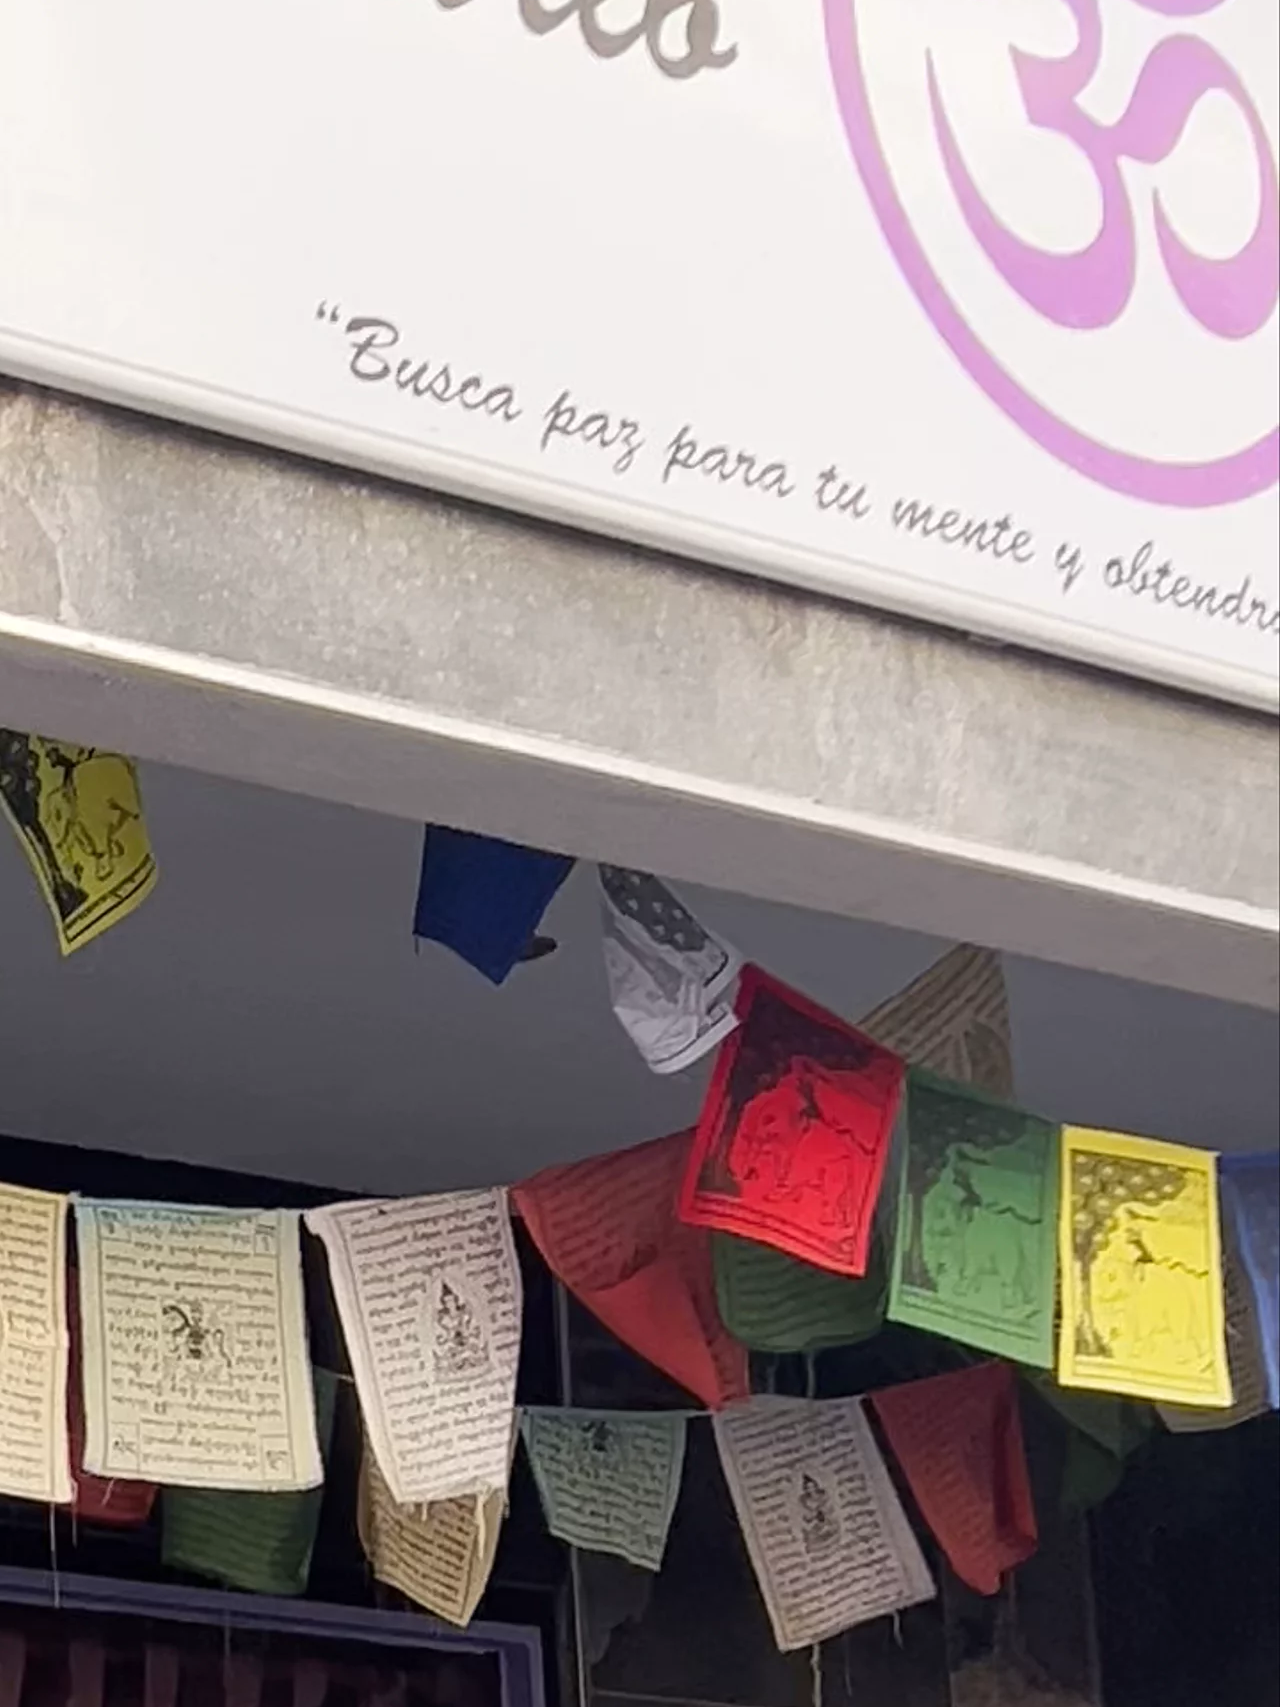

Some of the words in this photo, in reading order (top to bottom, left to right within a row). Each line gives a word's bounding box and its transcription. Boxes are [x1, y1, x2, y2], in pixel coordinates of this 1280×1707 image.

[539, 390, 646, 474] paz
[661, 424, 795, 498] para
[813, 464, 872, 519] tu
[891, 496, 1037, 563] mente
[1054, 542, 1085, 594] y
